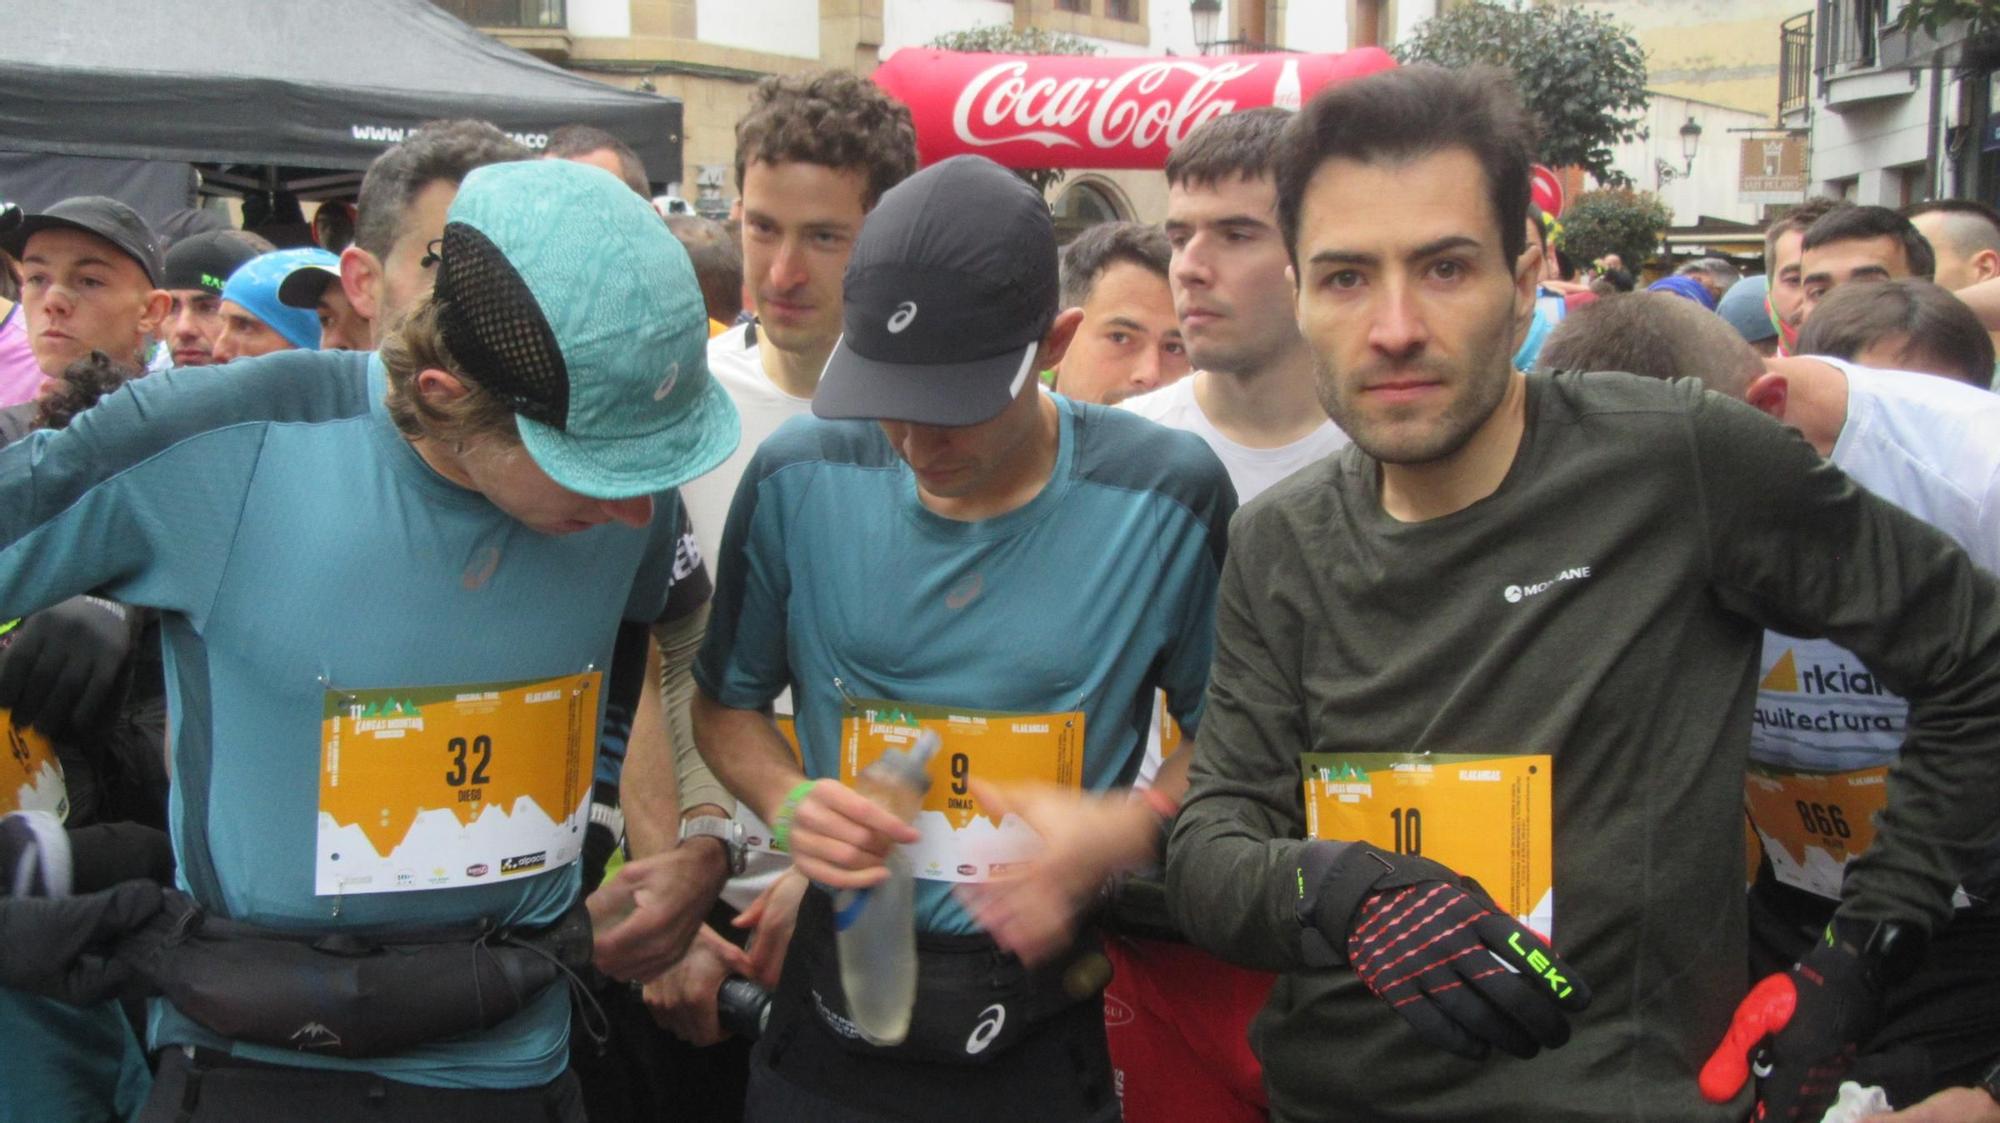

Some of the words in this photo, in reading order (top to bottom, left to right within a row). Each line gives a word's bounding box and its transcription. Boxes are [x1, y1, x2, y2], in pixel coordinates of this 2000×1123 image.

[1523, 566, 1591, 597] MOANE
[1753, 707, 1893, 734] quitectura
[446, 735, 492, 786] 32
[951, 752, 969, 795] 9
[458, 789, 482, 803] DIEGO
[948, 798, 973, 810] DIMAS
[1390, 807, 1421, 856] 10
[1508, 931, 1573, 999] LEKI
